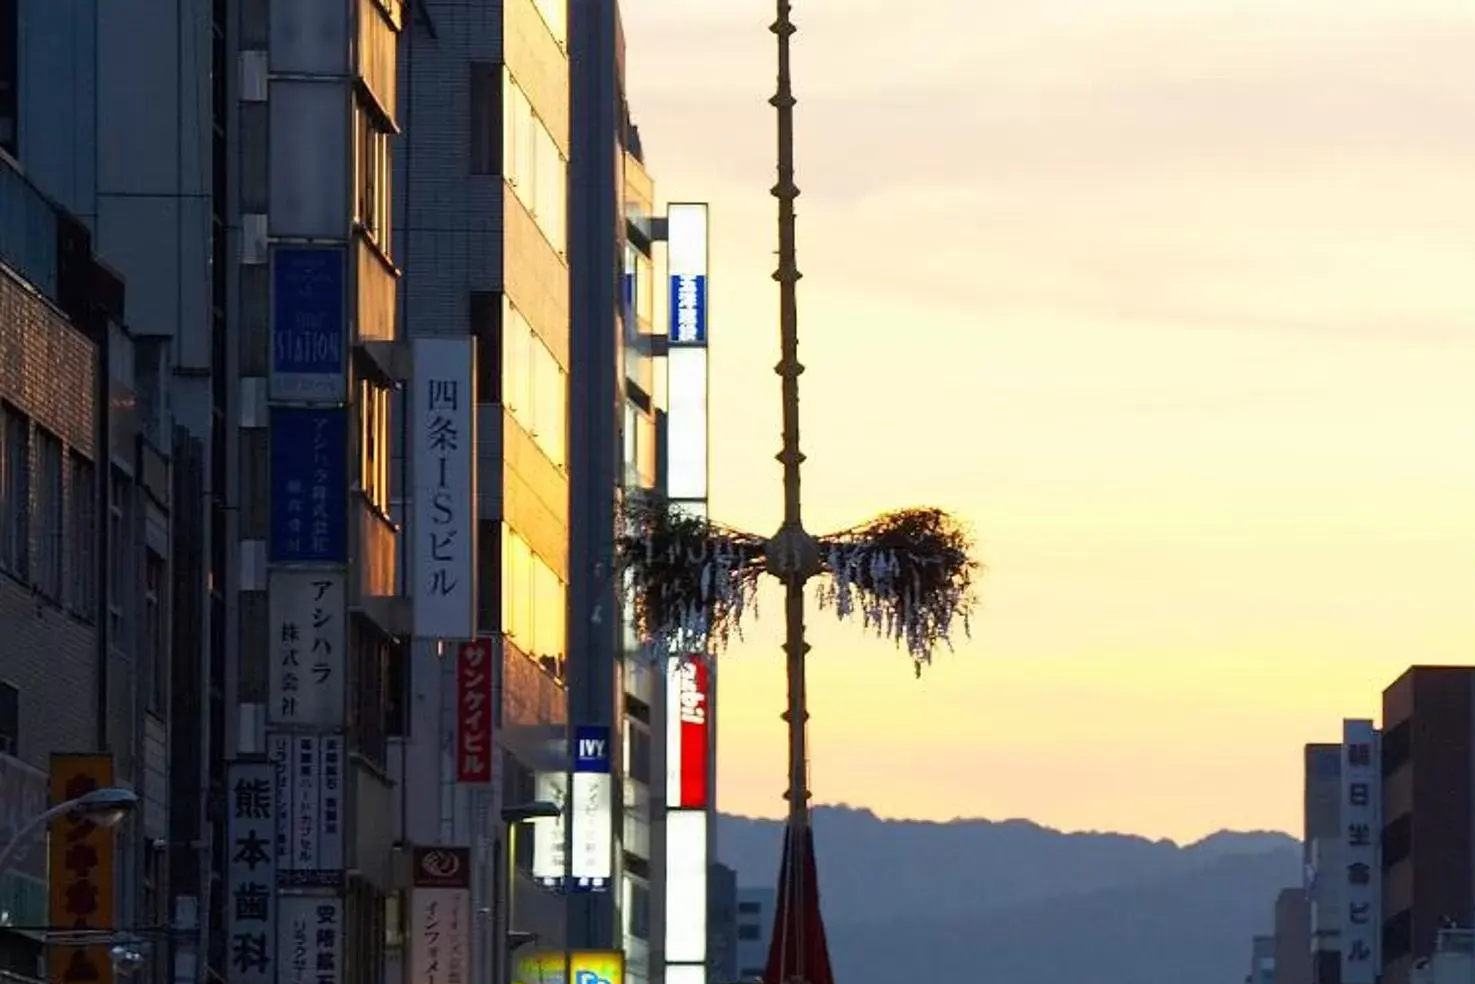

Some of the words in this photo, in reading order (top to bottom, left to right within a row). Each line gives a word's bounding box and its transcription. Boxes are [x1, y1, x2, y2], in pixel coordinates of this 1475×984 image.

[280, 622, 300, 717] 株式会社
[310, 580, 334, 686] アシハラ
[579, 739, 606, 757] IVY
[232, 778, 271, 974] 熊本歯科
